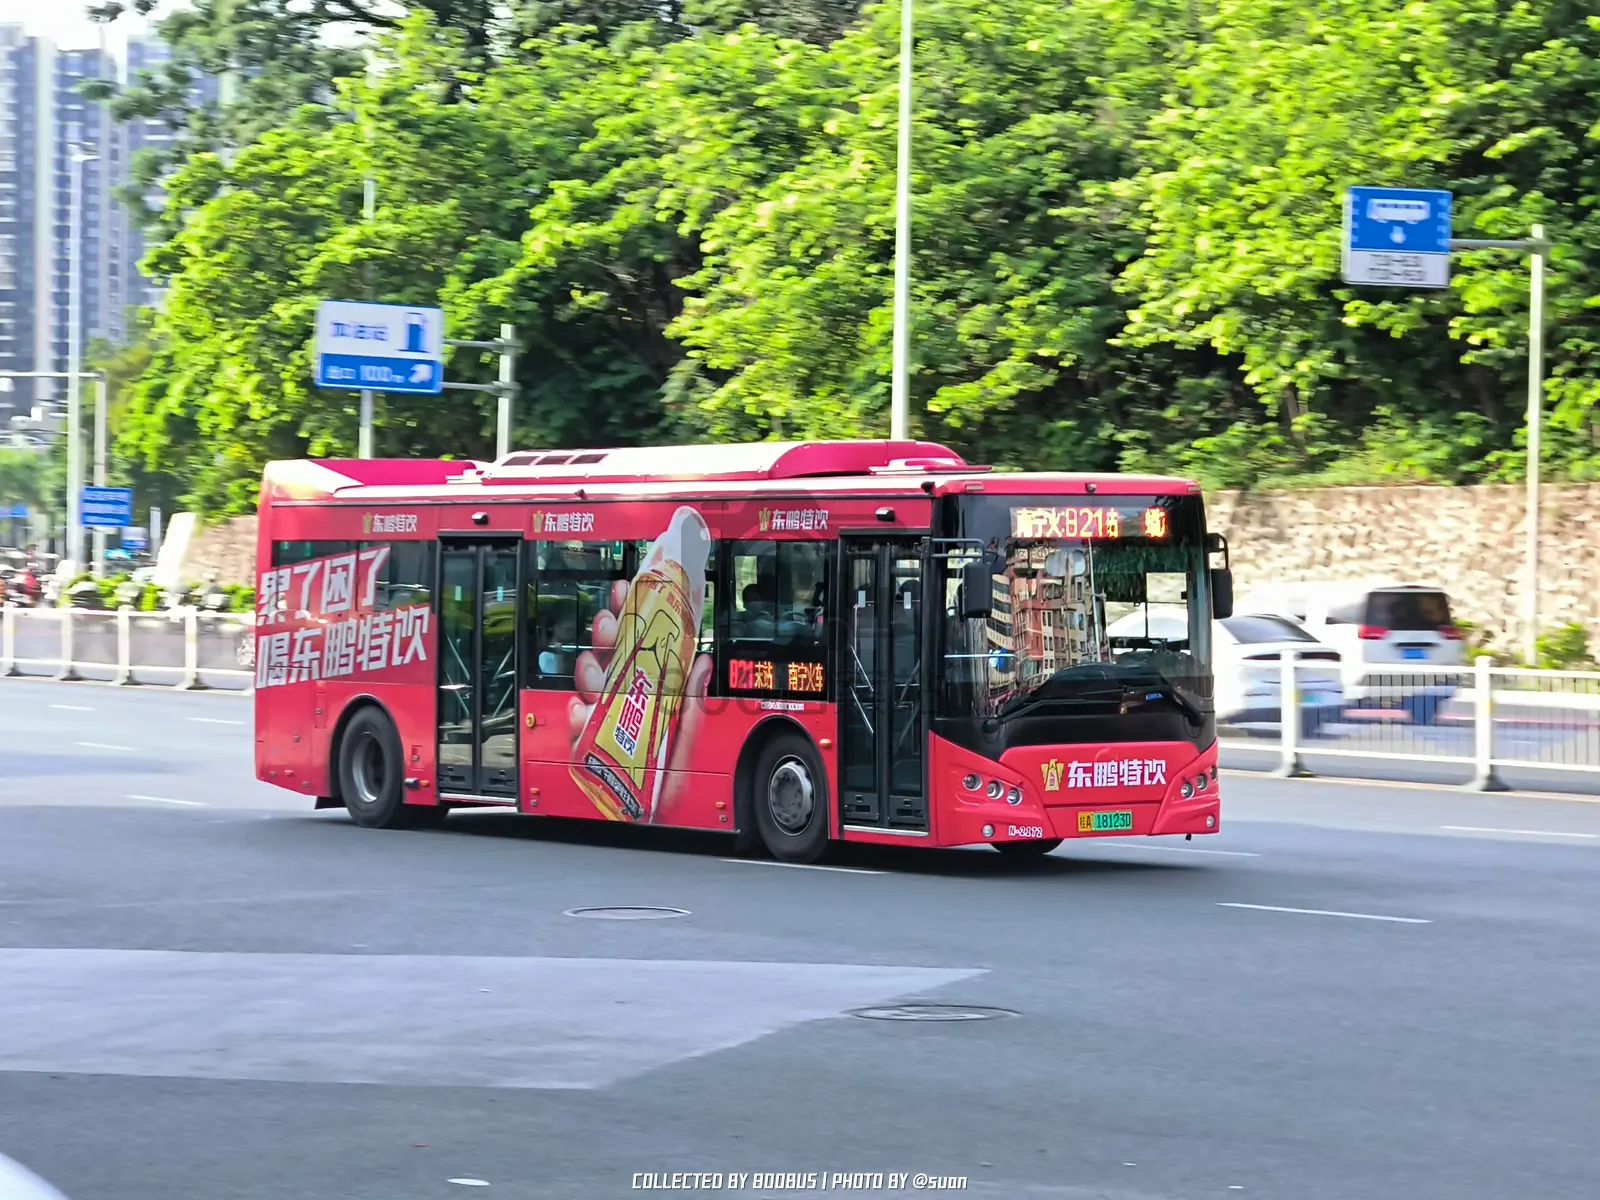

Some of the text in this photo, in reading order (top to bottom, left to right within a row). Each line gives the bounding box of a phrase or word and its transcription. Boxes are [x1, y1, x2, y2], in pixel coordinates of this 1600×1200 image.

[372, 513, 417, 533] 东鹏特饮
[544, 511, 594, 532] 东鹏特饮
[772, 509, 829, 530] 东鹏特饮
[256, 546, 391, 627] 累了困了
[255, 605, 430, 689] 喝东鹏特饮
[788, 662, 824, 691] 南宁火车
[1068, 759, 1167, 788] 东鹏特饮
